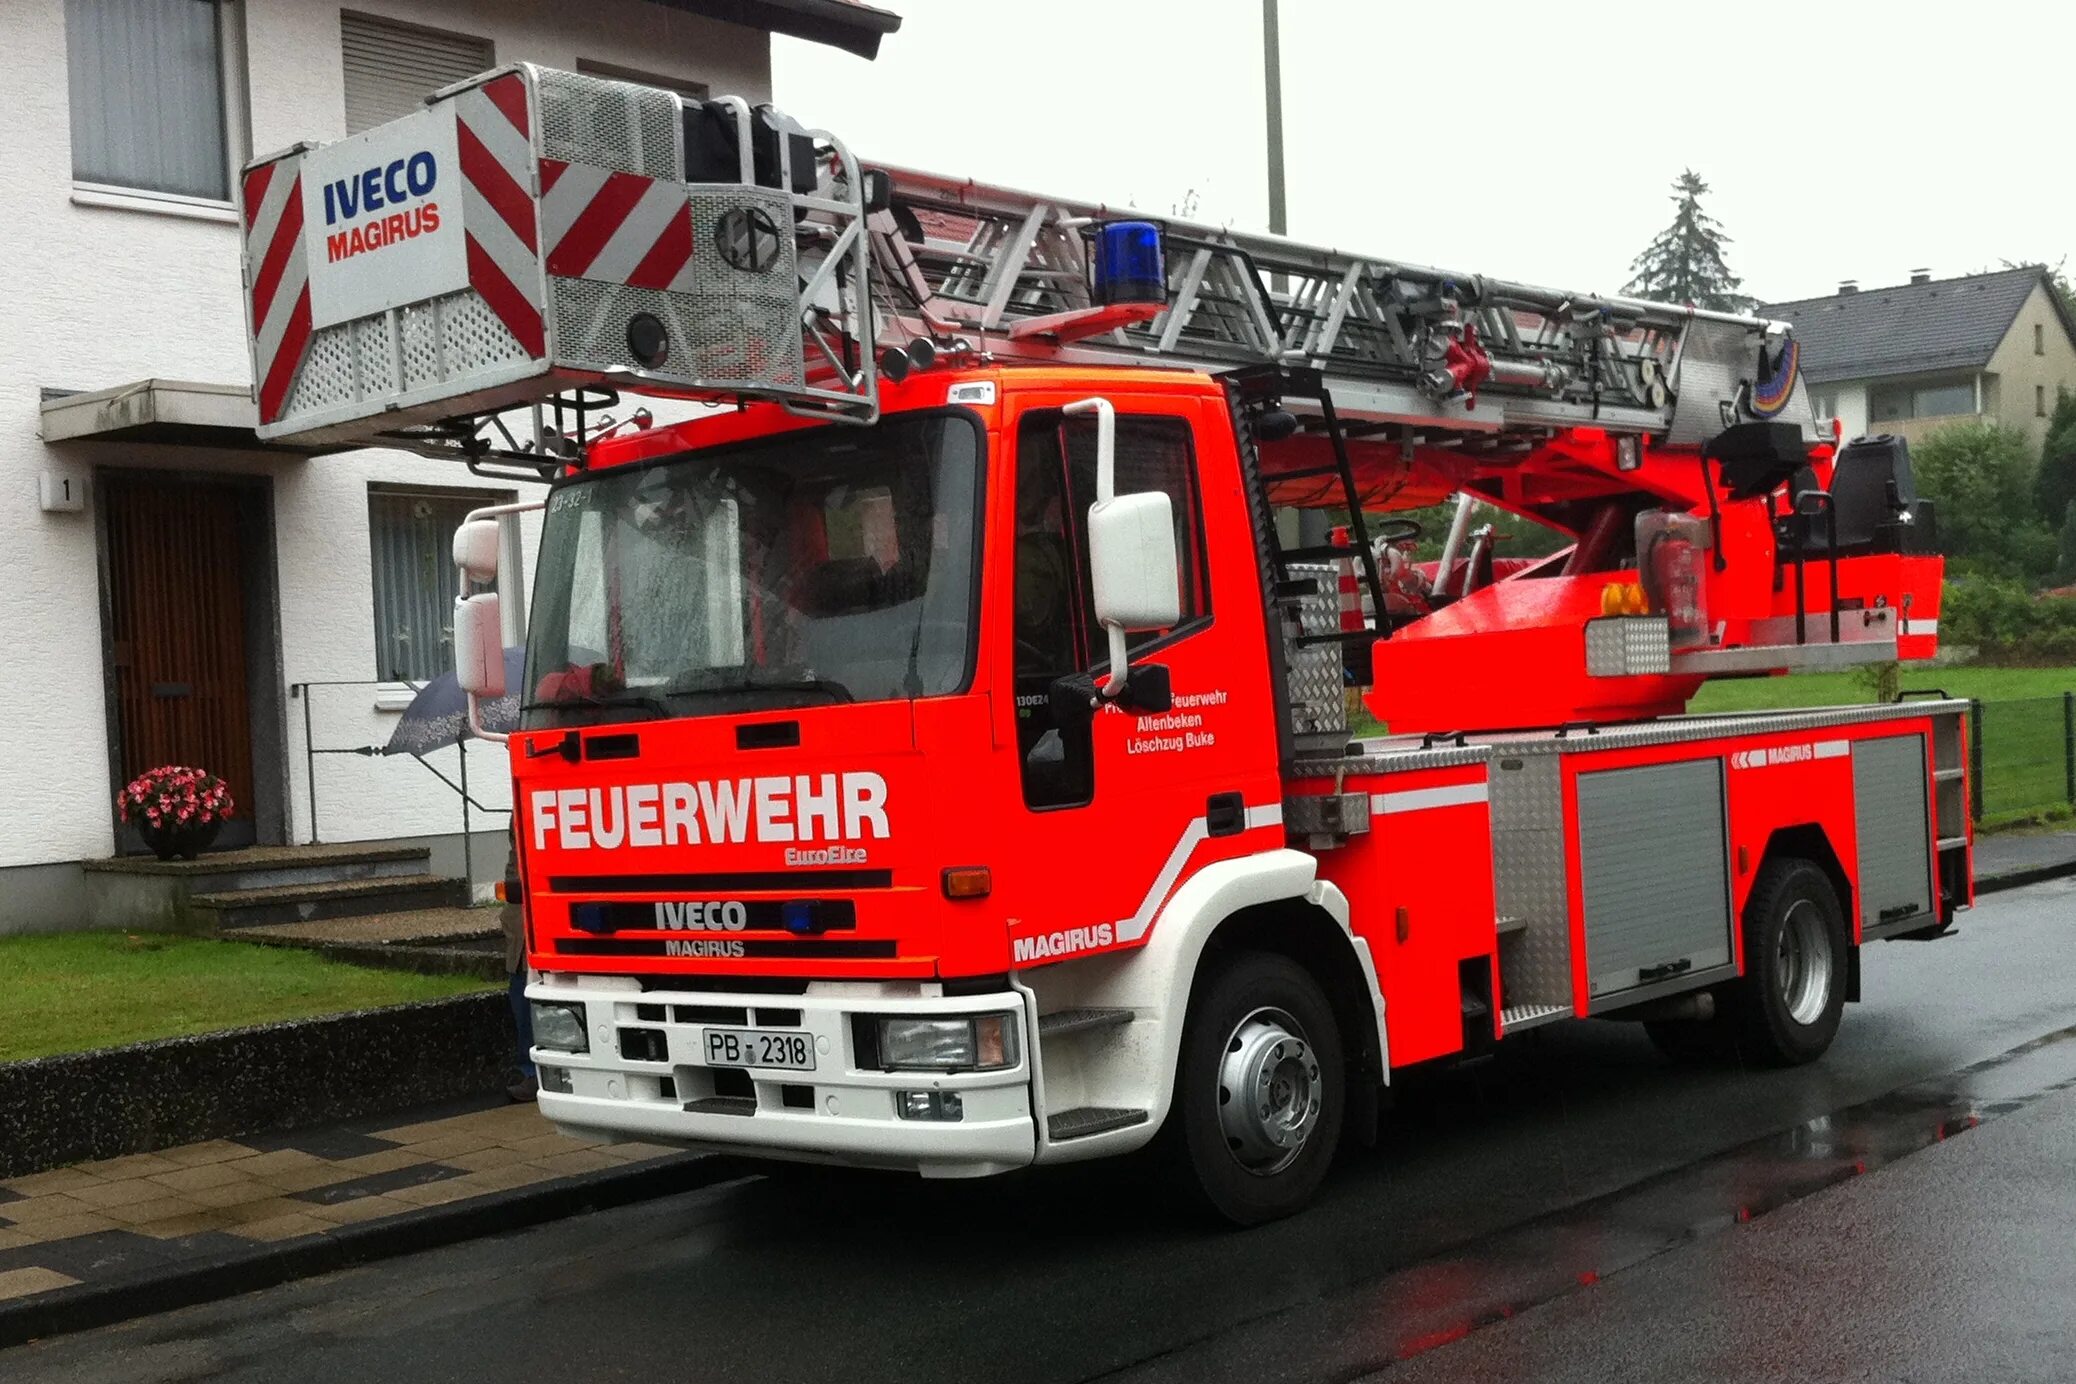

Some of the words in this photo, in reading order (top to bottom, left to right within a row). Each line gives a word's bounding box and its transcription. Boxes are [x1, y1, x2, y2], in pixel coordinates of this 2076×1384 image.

[323, 151, 437, 226] IVECO
[327, 202, 440, 264] MAGIRUS
[63, 479, 70, 501] 1
[1137, 713, 1202, 732] Altenbeken
[1126, 736, 1184, 755] Löschzug
[1185, 731, 1215, 748] Buke
[1768, 744, 1813, 766] MAGIRUS
[531, 771, 891, 850] FEUERWEHR
[655, 901, 747, 931] IVECO
[665, 940, 745, 958] MAGIRUS
[1013, 923, 1113, 962] MAGIRUS
[709, 1033, 740, 1061] PB
[760, 1036, 806, 1064] 2318
